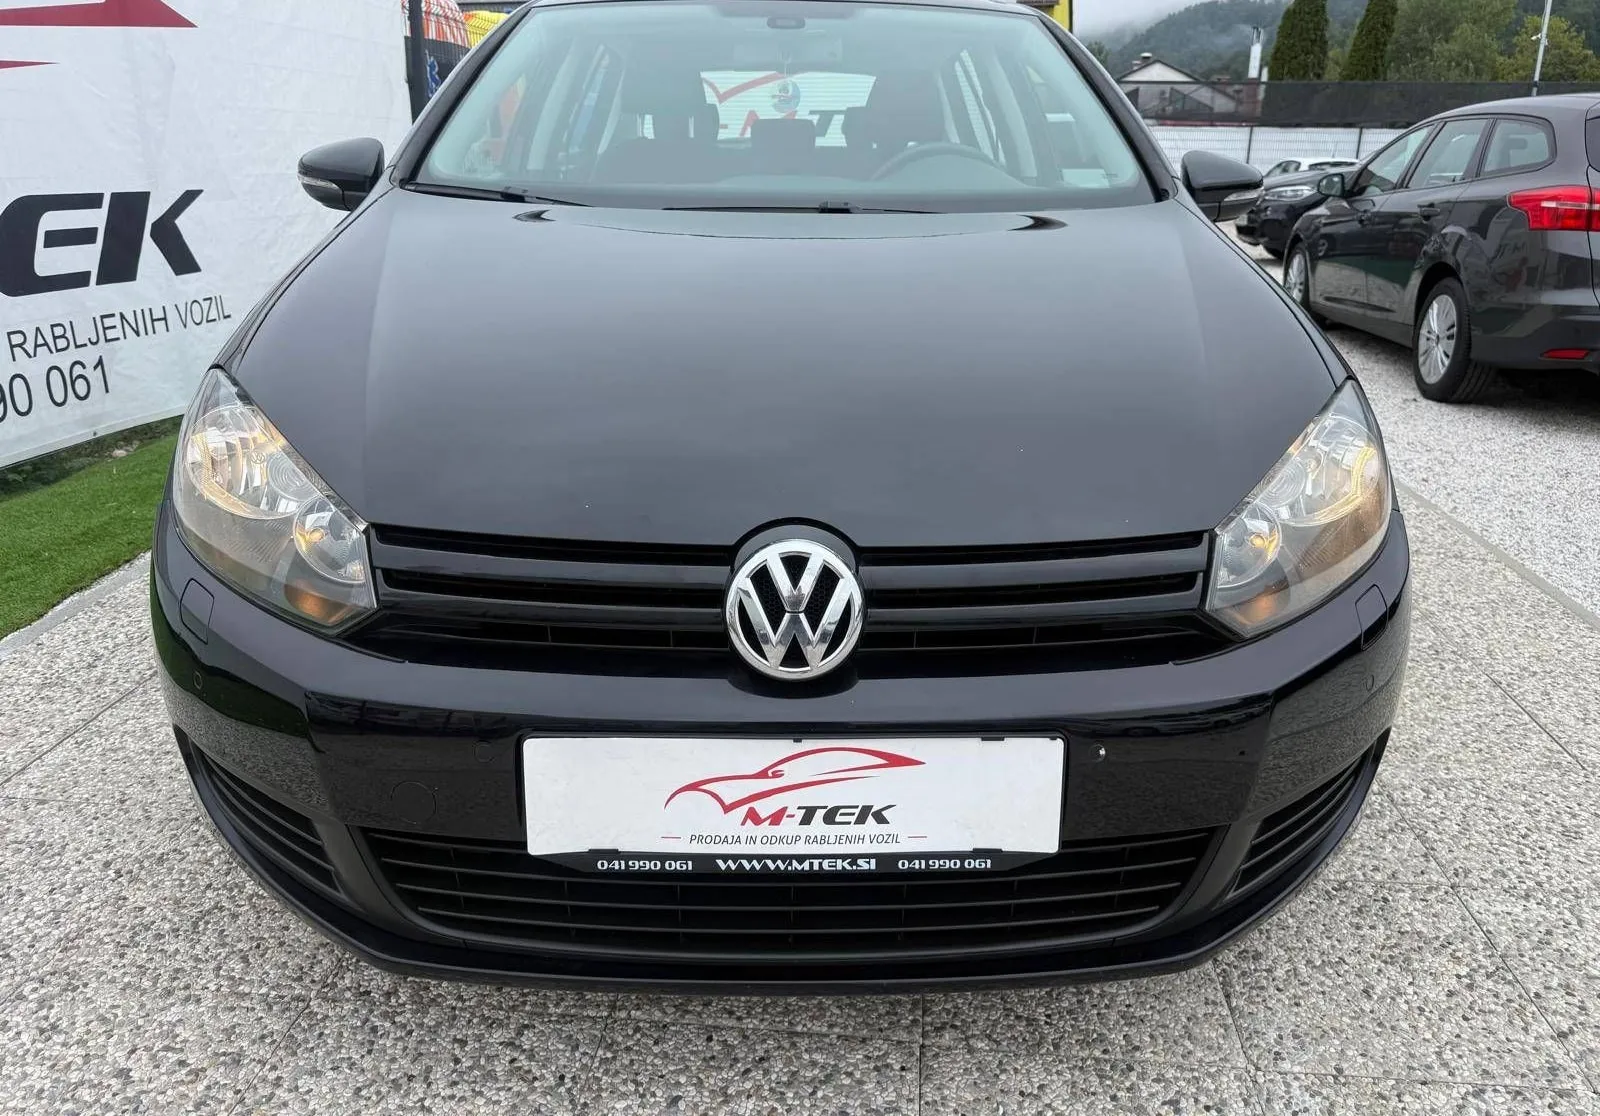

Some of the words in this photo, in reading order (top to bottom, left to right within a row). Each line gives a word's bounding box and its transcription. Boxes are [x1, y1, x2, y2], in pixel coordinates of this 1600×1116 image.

[6, 305, 170, 362] RABLJENIH
[174, 295, 232, 329] VOZIL
[46, 355, 110, 407] 061
[740, 804, 897, 826] M-TEK
[689, 834, 742, 845] PRODAJA
[745, 834, 757, 845] IN
[760, 834, 801, 846] ODKUP
[804, 833, 865, 845] RABLJENIH
[869, 832, 901, 845] VOZIL
[596, 860, 625, 871] 041
[628, 860, 661, 871] 990
[664, 860, 693, 871] 061
[715, 858, 876, 871] WWW.MTEK.SI
[898, 859, 925, 870] 041
[928, 859, 961, 870] 990
[964, 859, 992, 869] 061
